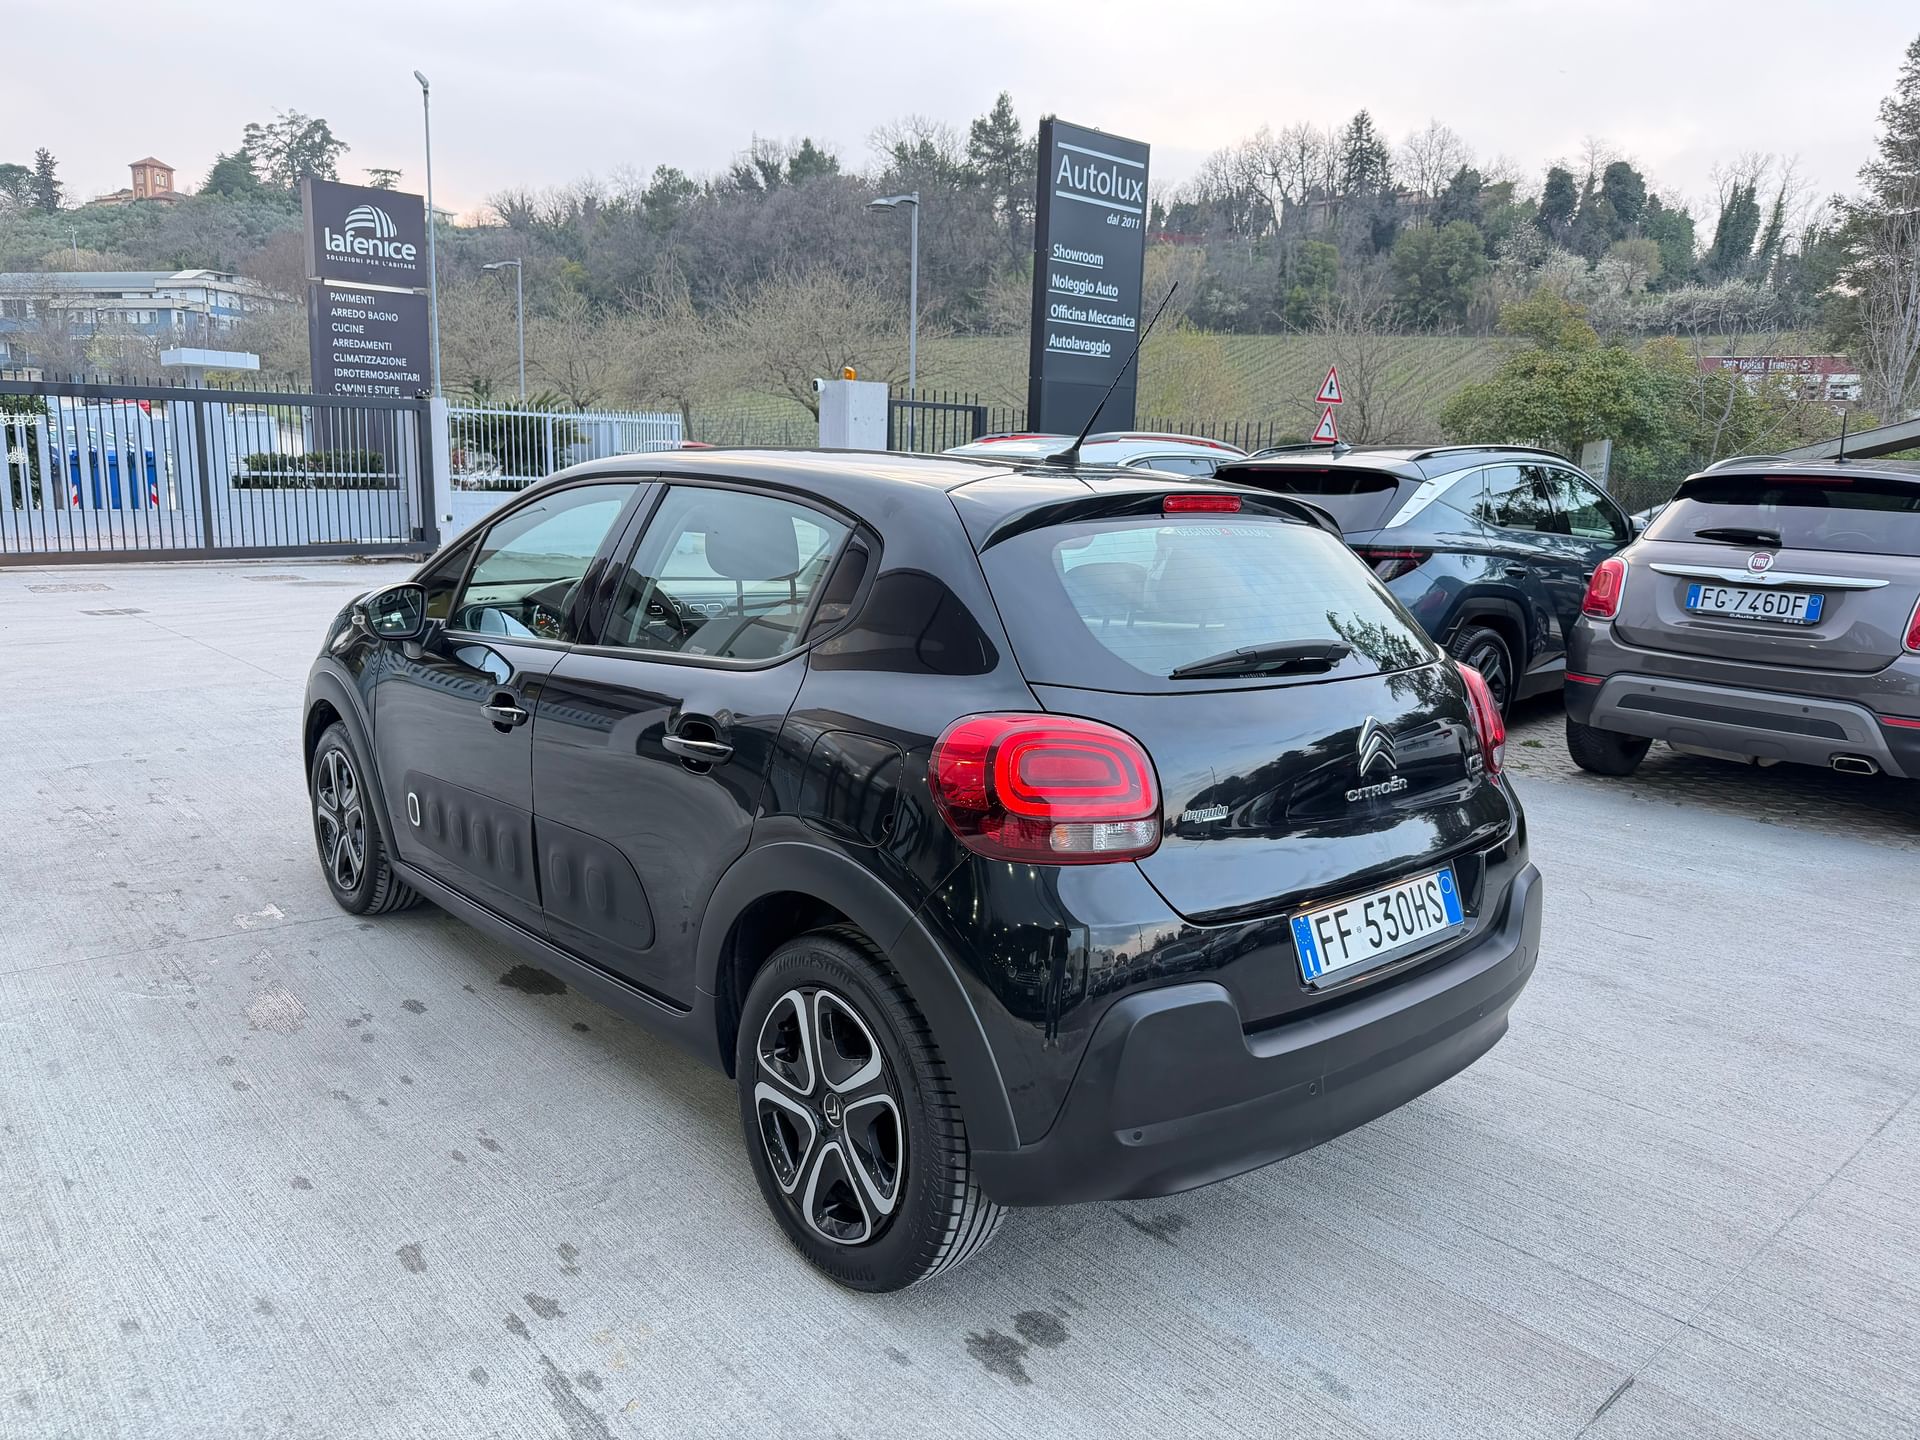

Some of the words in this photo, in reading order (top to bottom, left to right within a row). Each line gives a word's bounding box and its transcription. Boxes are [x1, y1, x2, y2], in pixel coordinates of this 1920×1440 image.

[1056, 155, 1143, 203] Autolux
[1107, 213, 1120, 226] dal
[1121, 215, 1141, 230] 2011
[324, 227, 416, 261] lafenice
[326, 254, 363, 264] SOLUZIONI
[1053, 243, 1104, 265] Showroom
[1052, 273, 1095, 295] Noleggio
[1096, 281, 1119, 297] Auto
[330, 292, 375, 305] PAVIMENTI
[330, 307, 366, 319] ARREDO
[367, 311, 399, 322] BAGNO
[1050, 304, 1087, 321] Officina
[1088, 309, 1136, 328] Meccanica
[331, 322, 365, 334] CUCINE
[332, 338, 392, 351] ARREDAMENTI
[1049, 333, 1111, 355] Autolavaggio
[333, 353, 407, 367] CLIMATIZZAZIONE
[334, 368, 420, 382] IDROTERMOSANITARI
[367, 385, 373, 394] E
[1753, 557, 1769, 568] FIAT
[1700, 588, 1728, 609] FG
[1733, 591, 1807, 616] 746DF
[1345, 775, 1408, 802] CITROËN
[1314, 908, 1352, 966] FF
[1363, 880, 1444, 949] 530HS
